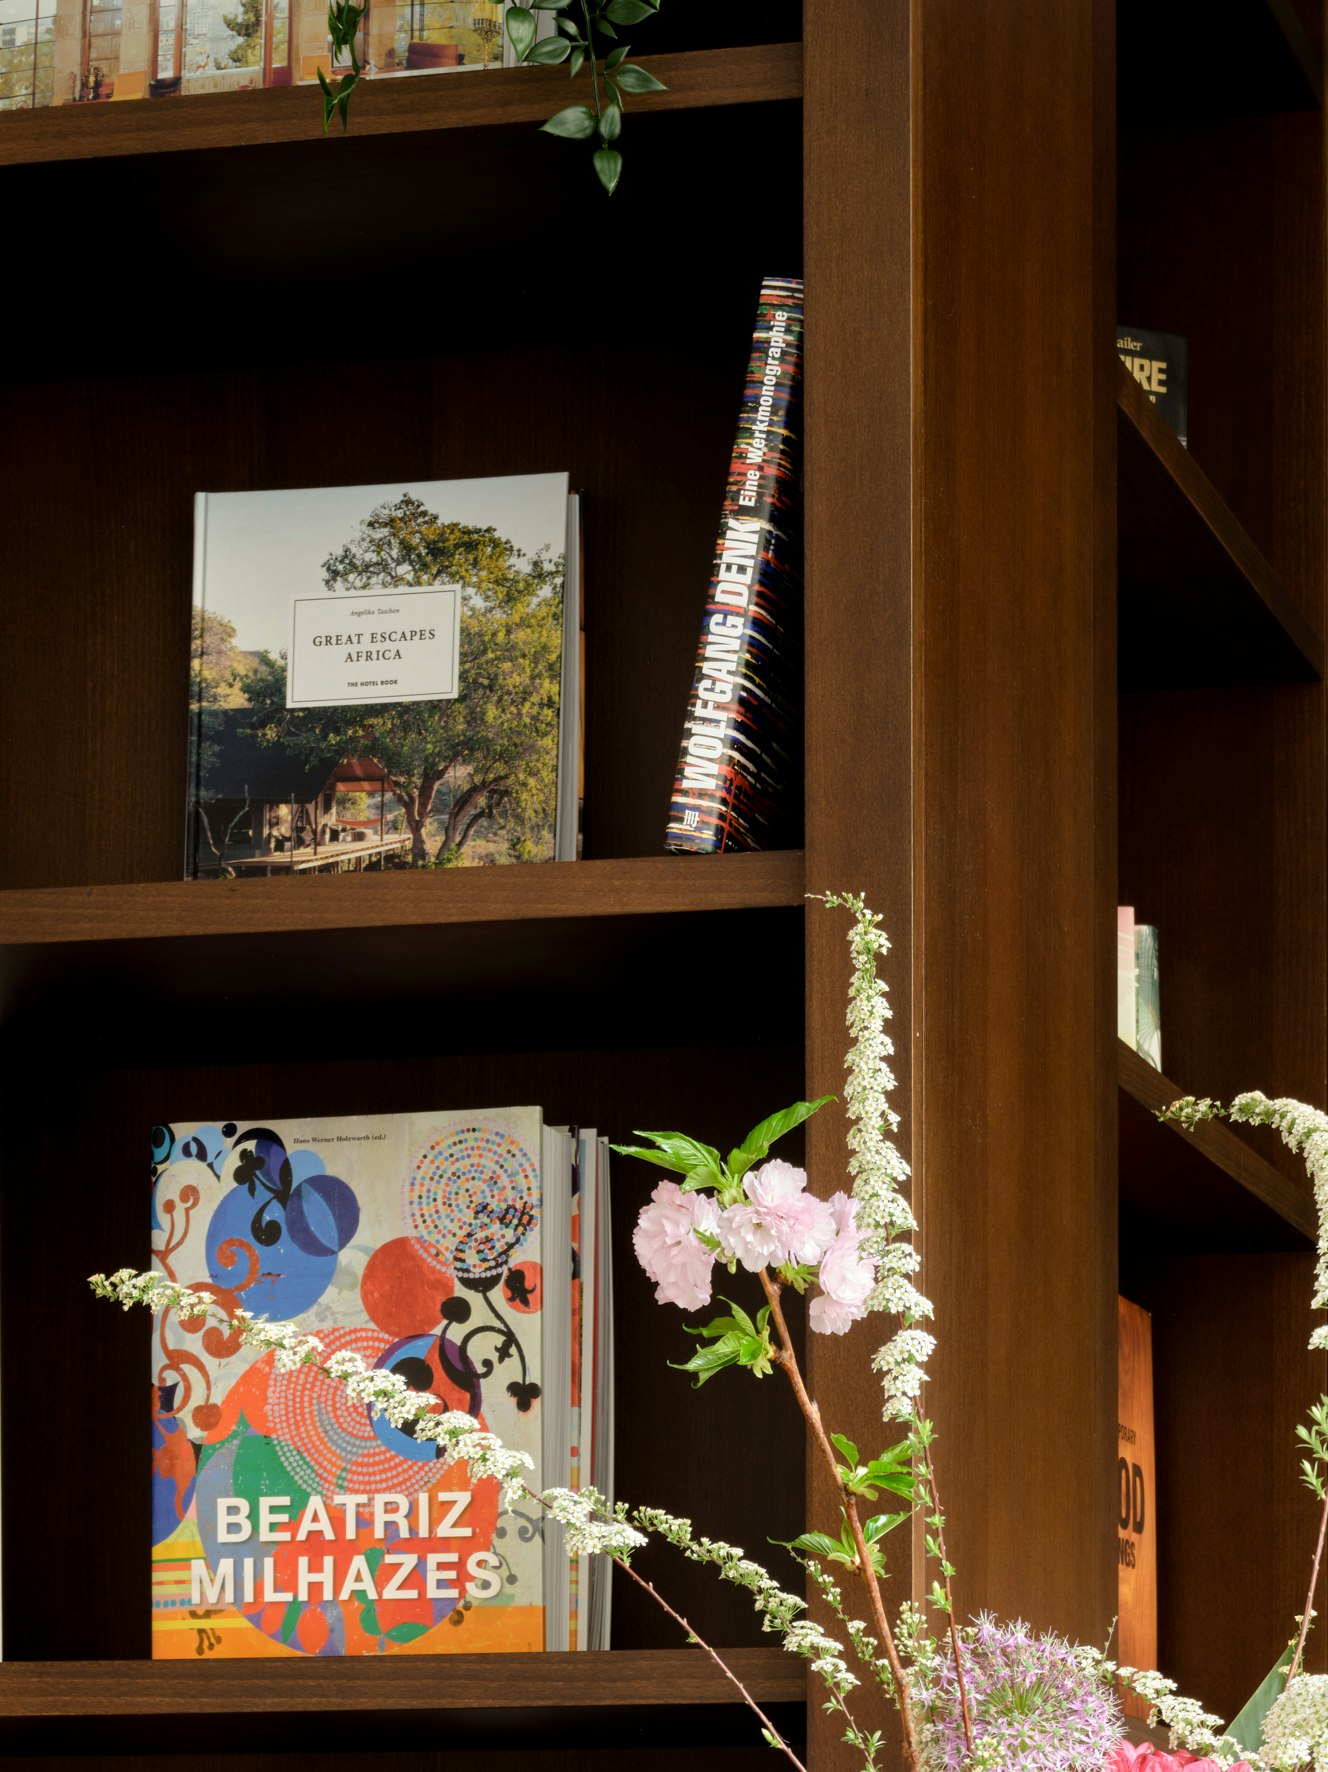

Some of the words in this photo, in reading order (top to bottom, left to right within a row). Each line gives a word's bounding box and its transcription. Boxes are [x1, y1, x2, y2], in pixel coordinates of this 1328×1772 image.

[746, 310, 794, 464] Werkmonographie
[739, 469, 760, 507] Eine
[714, 518, 761, 605] DENK
[350, 609, 375, 618] Angelika
[378, 608, 400, 616] Taschen
[312, 633, 364, 647] GREAT
[370, 629, 436, 644] ESCAPES
[344, 649, 402, 663] AFRICA
[682, 613, 745, 790] WOLFGANG
[336, 1134, 370, 1142] Holzwarth
[216, 1491, 472, 1544] BEATRIZ
[190, 1551, 501, 1604] MILHAZES
